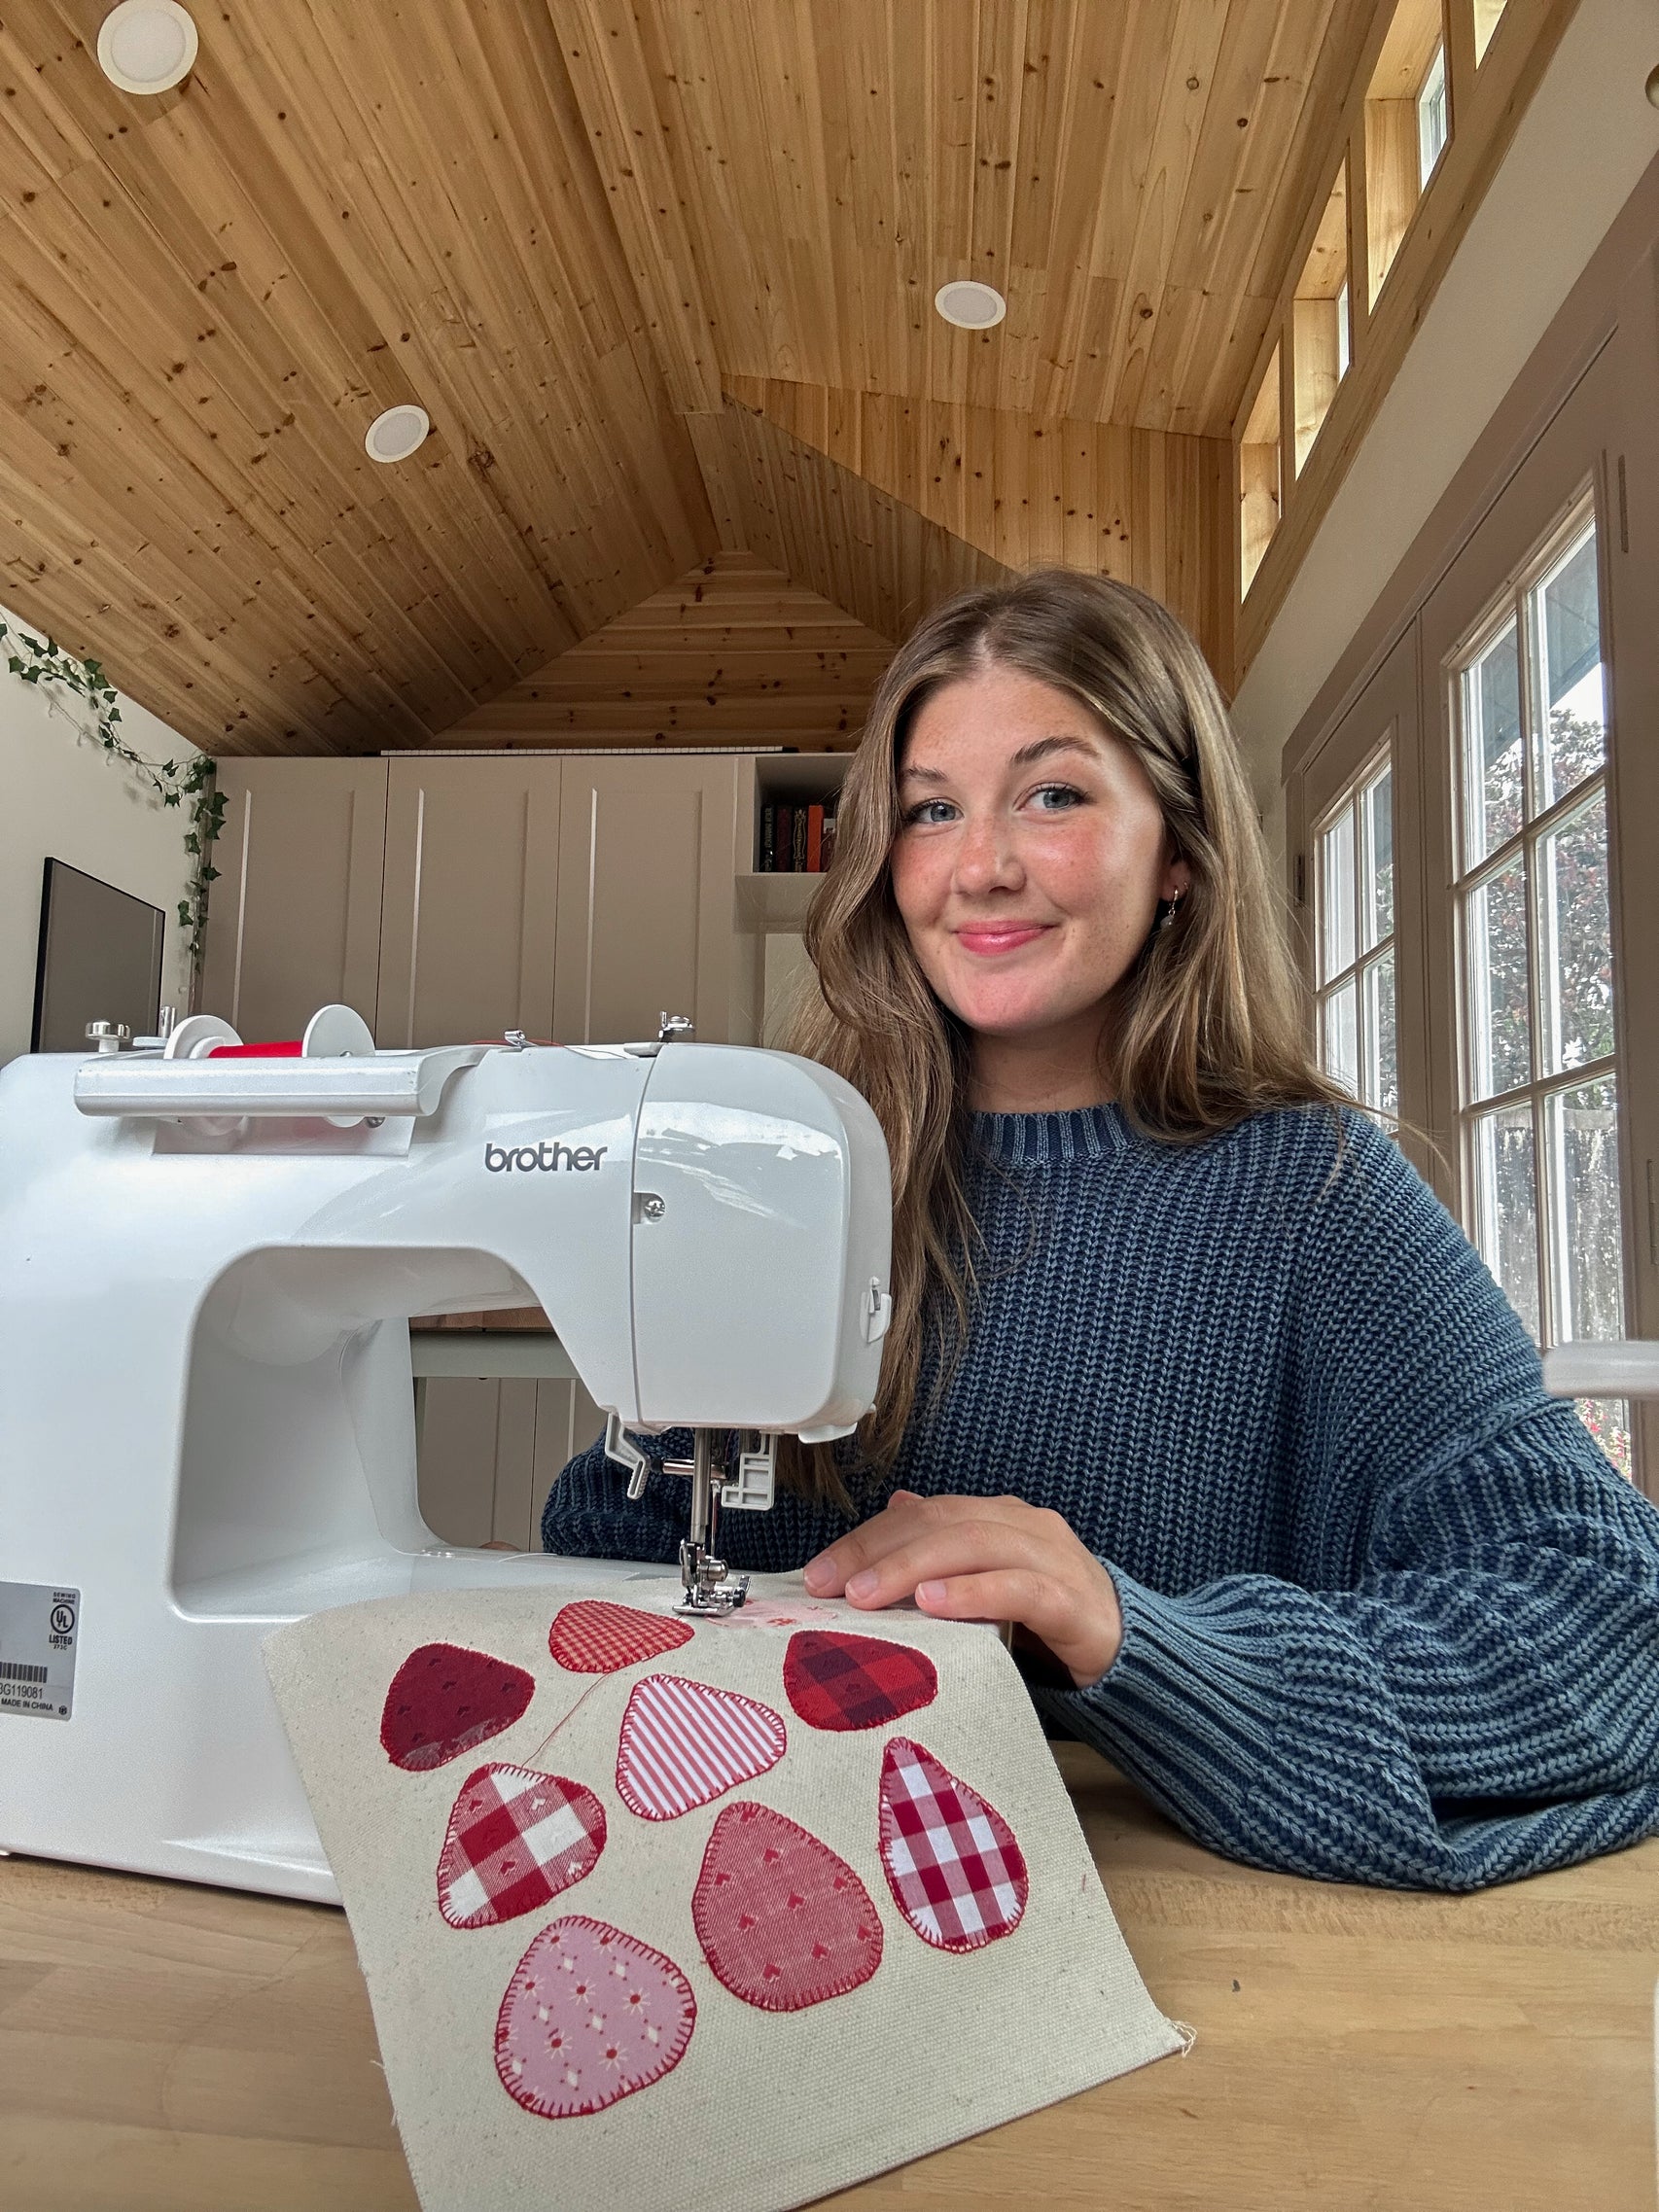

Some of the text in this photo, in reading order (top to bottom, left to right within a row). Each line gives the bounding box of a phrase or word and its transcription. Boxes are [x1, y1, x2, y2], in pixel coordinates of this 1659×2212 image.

[484, 1141, 608, 1173] brother
[49, 1634, 73, 1645] LISTED
[1, 1698, 21, 1707] MADE
[31, 1701, 53, 1711] CHINA
